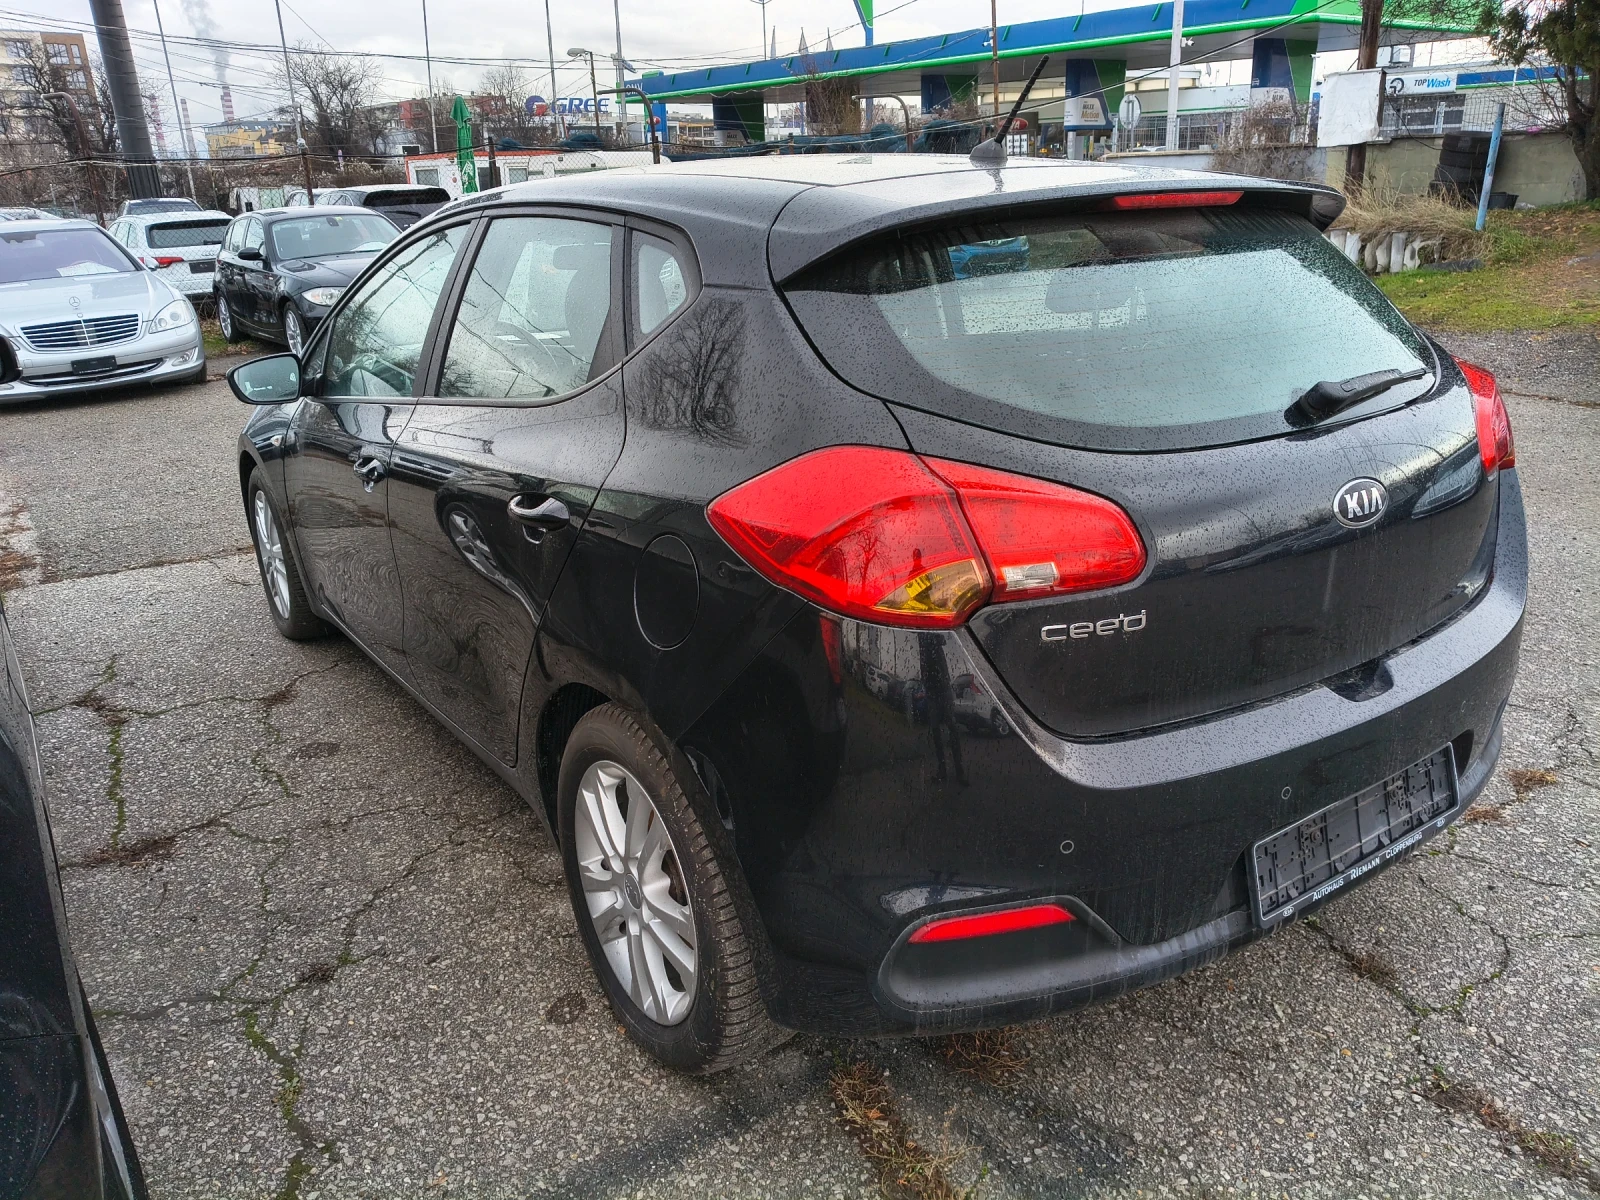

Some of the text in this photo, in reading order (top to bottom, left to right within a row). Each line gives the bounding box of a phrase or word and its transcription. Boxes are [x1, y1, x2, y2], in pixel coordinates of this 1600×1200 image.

[551, 97, 610, 114] GREE
[1343, 487, 1383, 519] KIA
[1312, 831, 1423, 902] AUTOHAUS RIEMANN CLOPPENBURG
